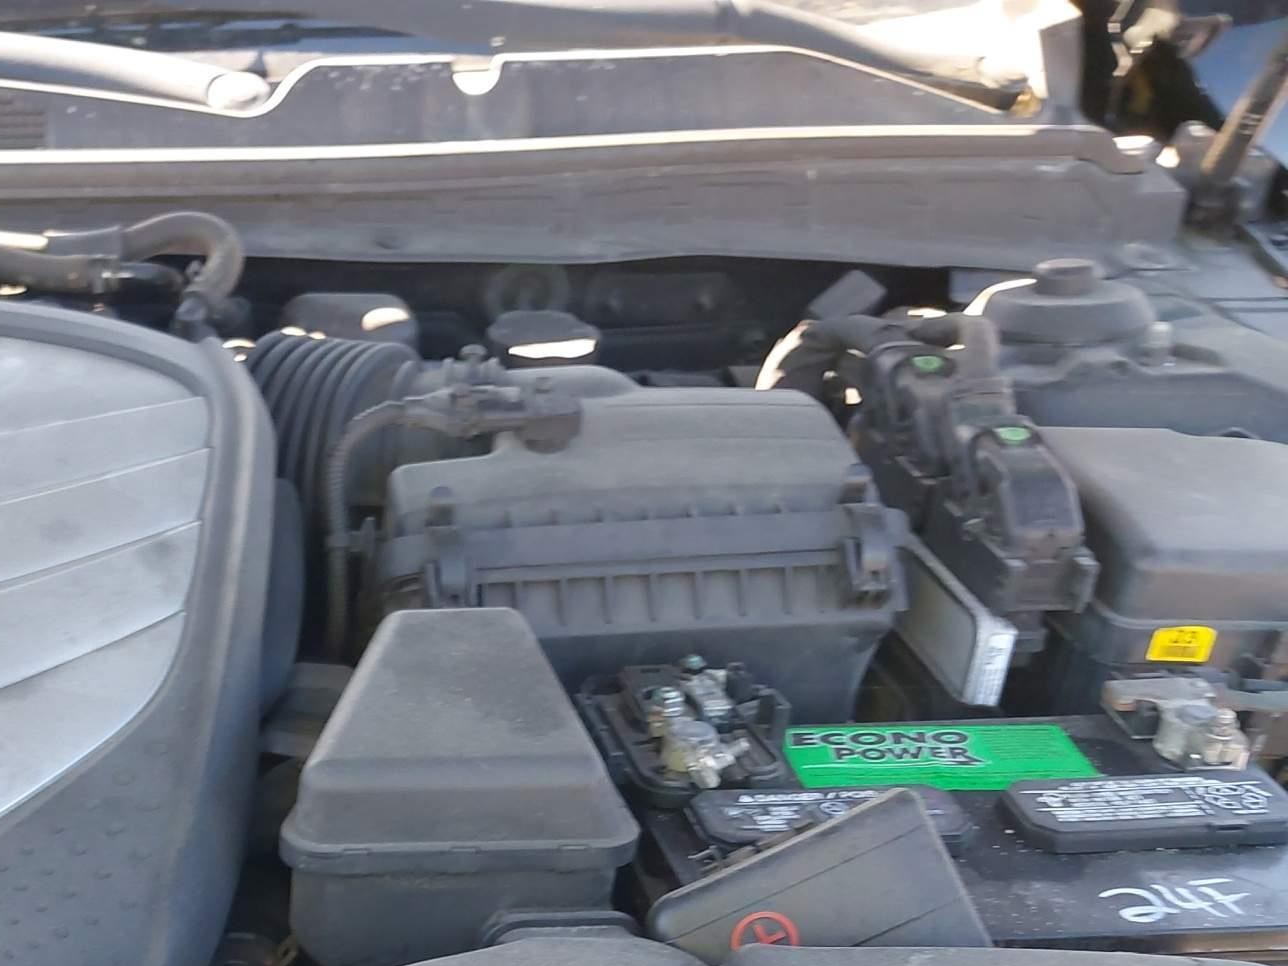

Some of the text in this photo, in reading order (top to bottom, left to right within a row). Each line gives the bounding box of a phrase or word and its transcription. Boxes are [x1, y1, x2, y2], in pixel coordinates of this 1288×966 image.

[789, 730, 969, 747] ECONO
[833, 746, 976, 763] POWER
[1098, 878, 1252, 923] 24F
